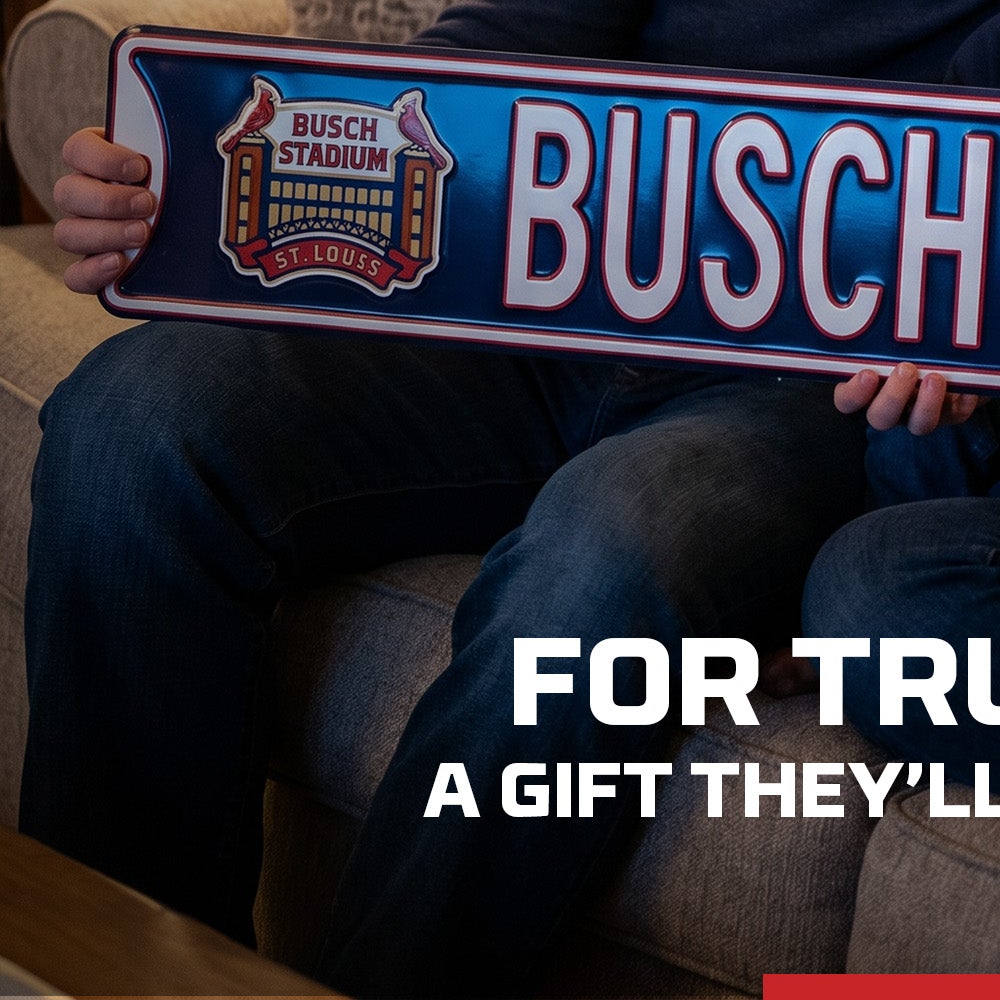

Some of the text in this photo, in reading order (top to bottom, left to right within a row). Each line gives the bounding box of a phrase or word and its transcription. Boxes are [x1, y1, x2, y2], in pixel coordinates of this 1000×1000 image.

[292, 113, 378, 142] BUSCH
[278, 141, 389, 172] STADIUM
[503, 99, 993, 349] BUSCH
[274, 246, 309, 270] ST.
